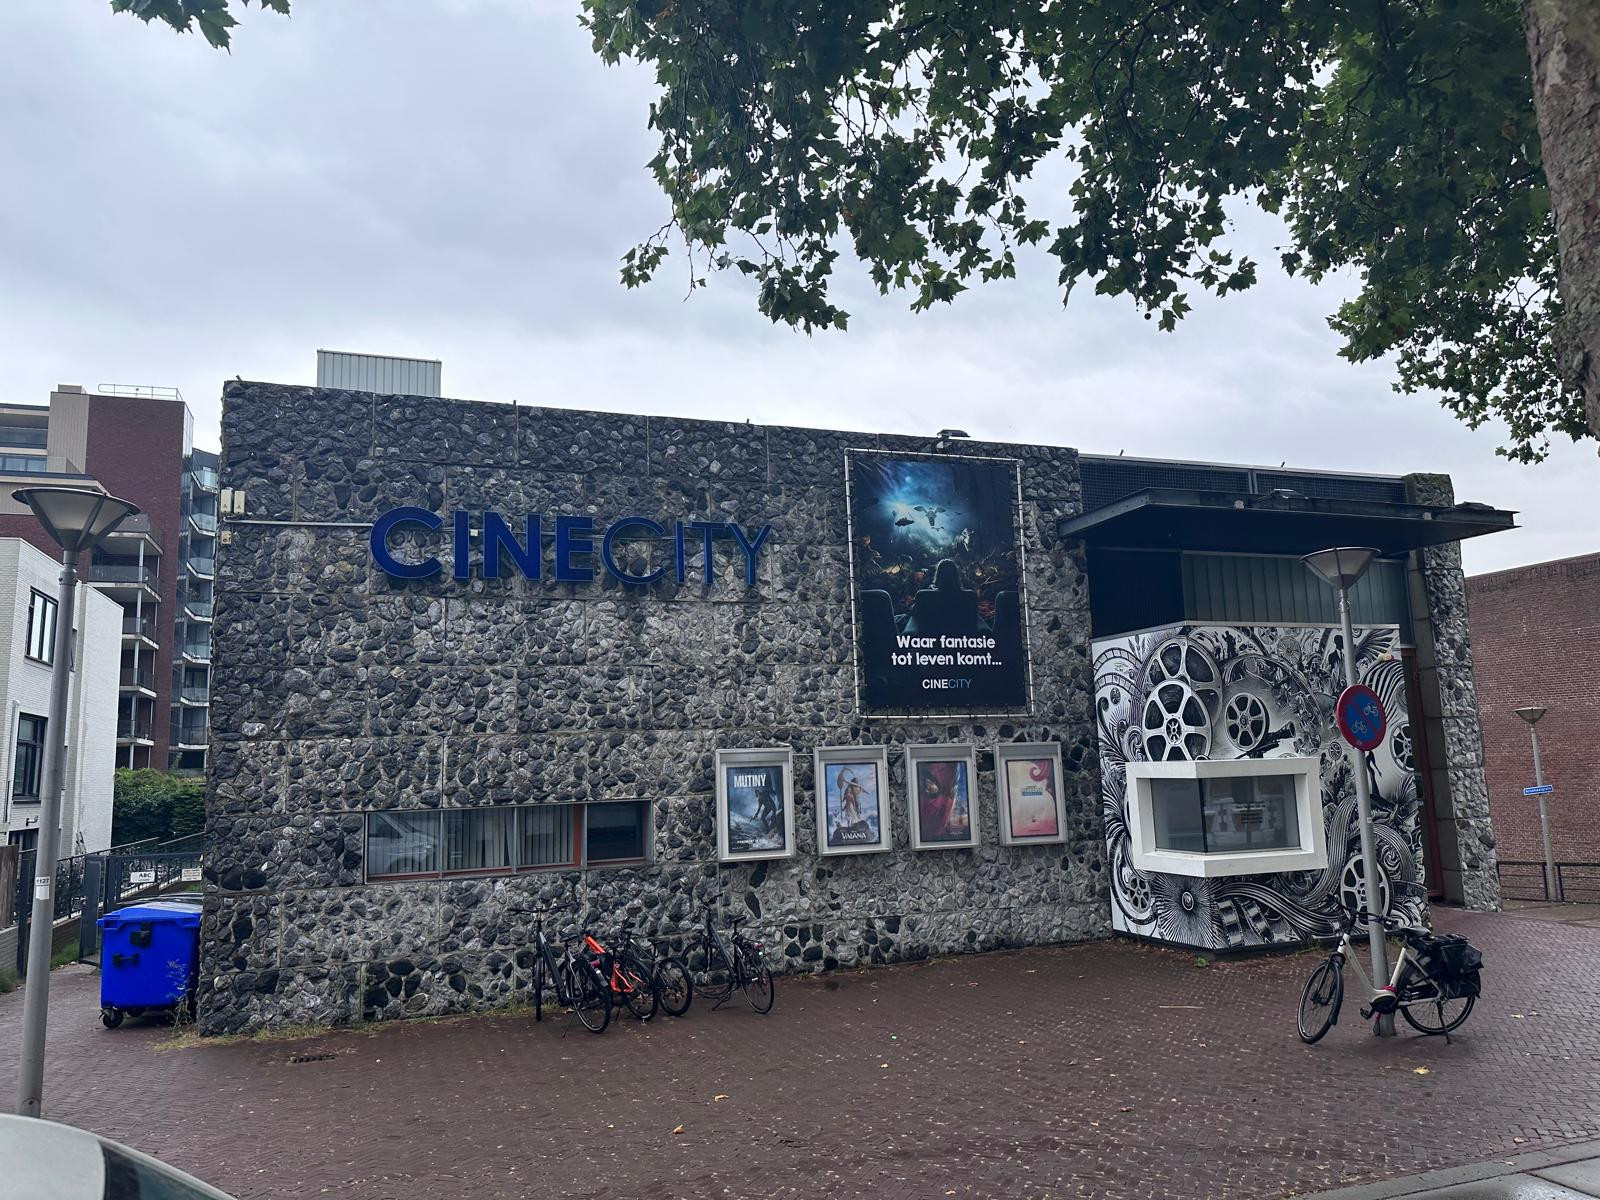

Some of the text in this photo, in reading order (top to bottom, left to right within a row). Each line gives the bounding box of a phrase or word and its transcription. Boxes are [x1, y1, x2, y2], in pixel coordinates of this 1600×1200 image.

[370, 506, 772, 585] CINECITY
[896, 635, 996, 649] Waar fantasie
[891, 652, 1002, 666] tot leven komt...
[922, 678, 972, 689] CINECITY
[733, 774, 767, 788] MUTINY
